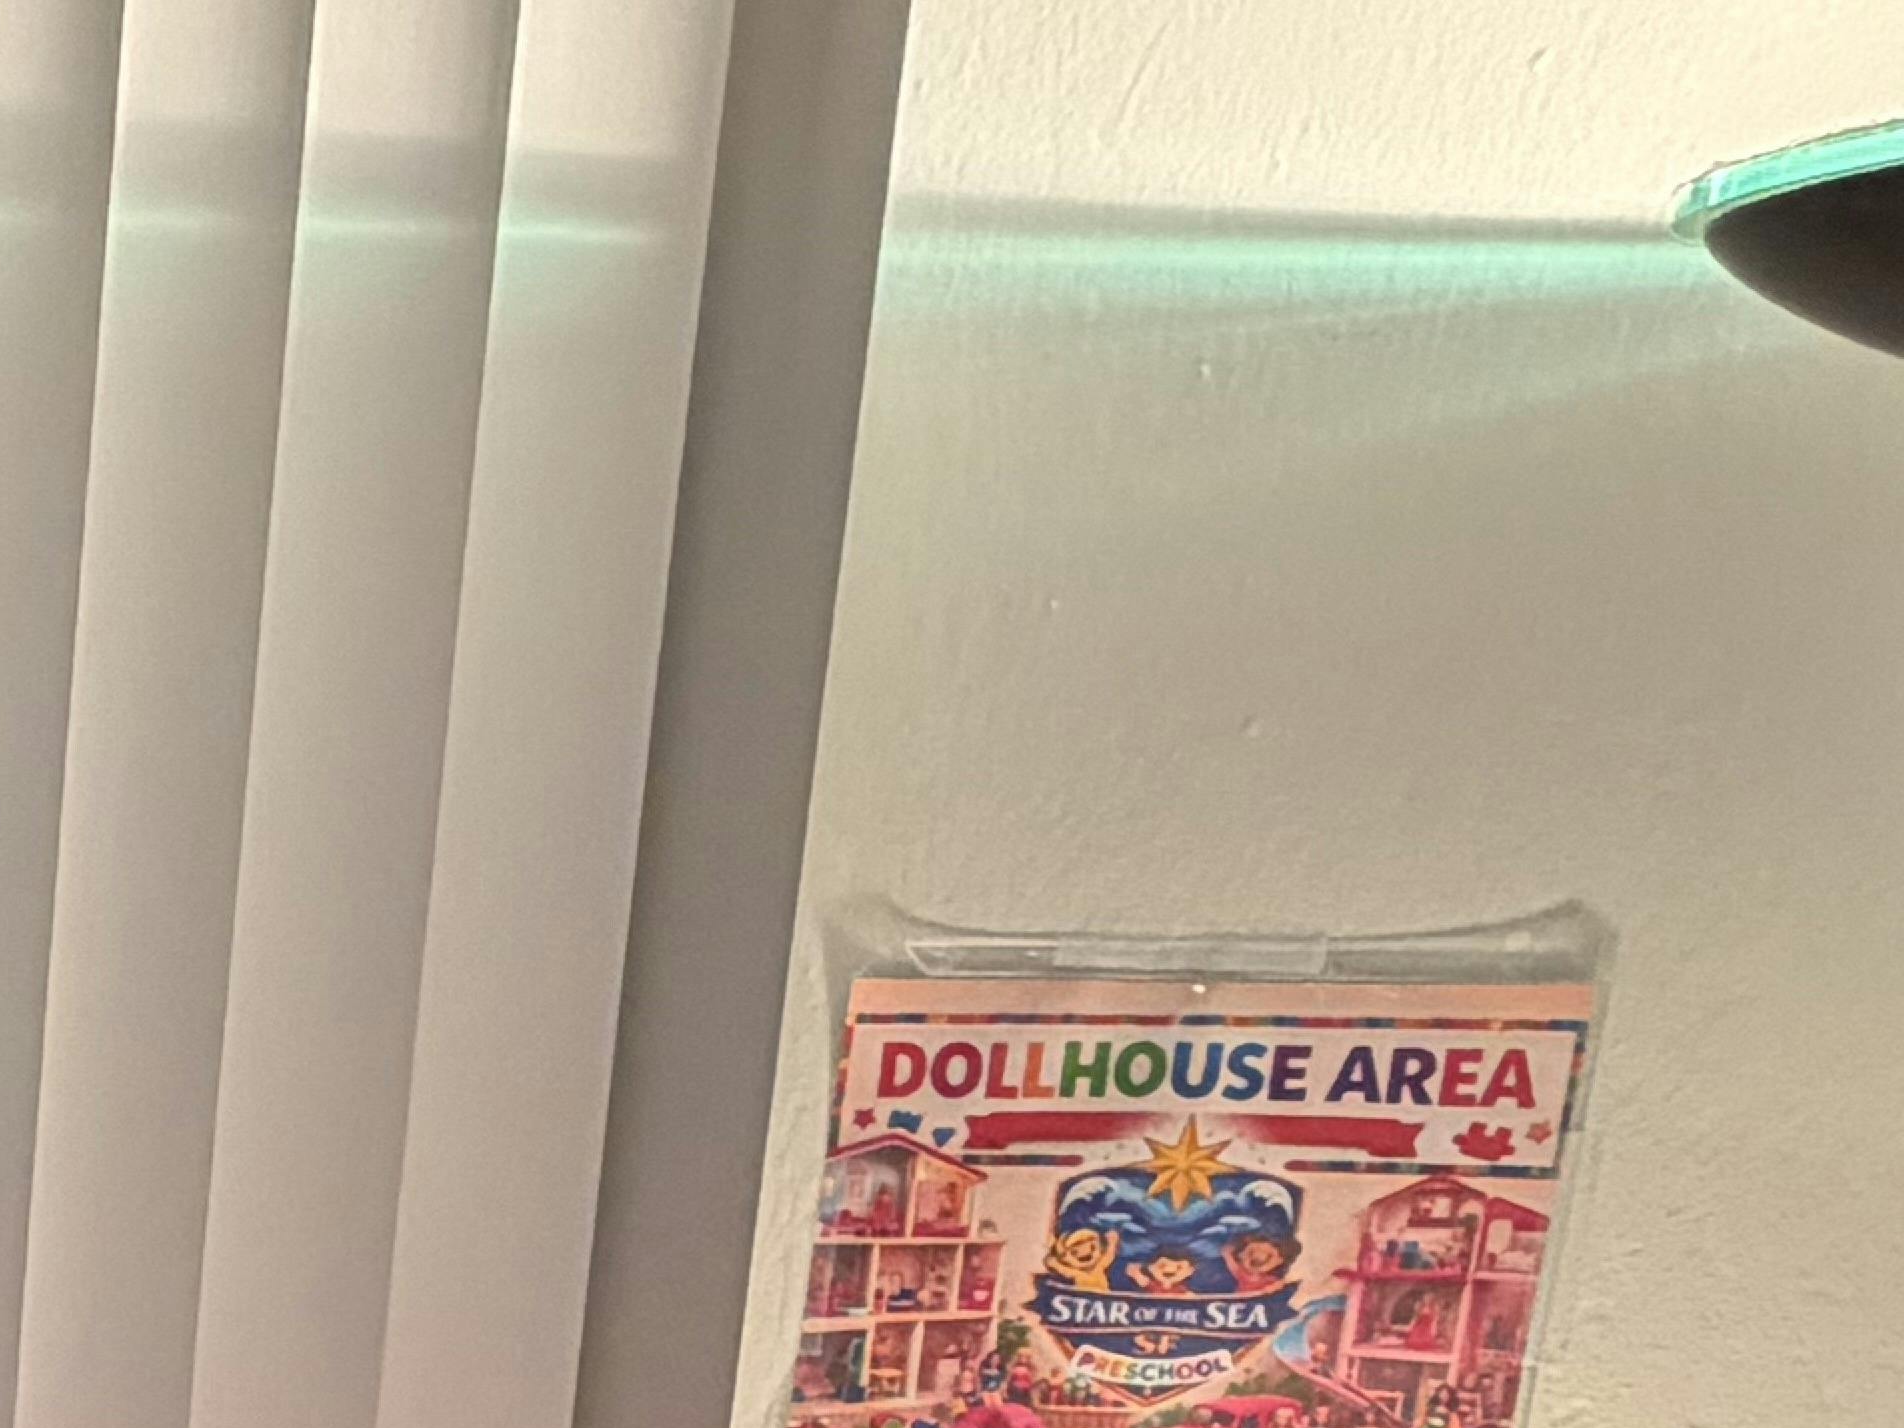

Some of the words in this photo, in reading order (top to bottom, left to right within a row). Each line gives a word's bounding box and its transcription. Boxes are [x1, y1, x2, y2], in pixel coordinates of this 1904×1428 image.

[876, 1041, 1314, 1102] DOLLHOUSE
[1322, 1045, 1536, 1109] AREA
[1047, 1294, 1130, 1326] STAR
[1203, 1300, 1270, 1329] SEA
[1077, 1351, 1229, 1381] PRESCHOOL
